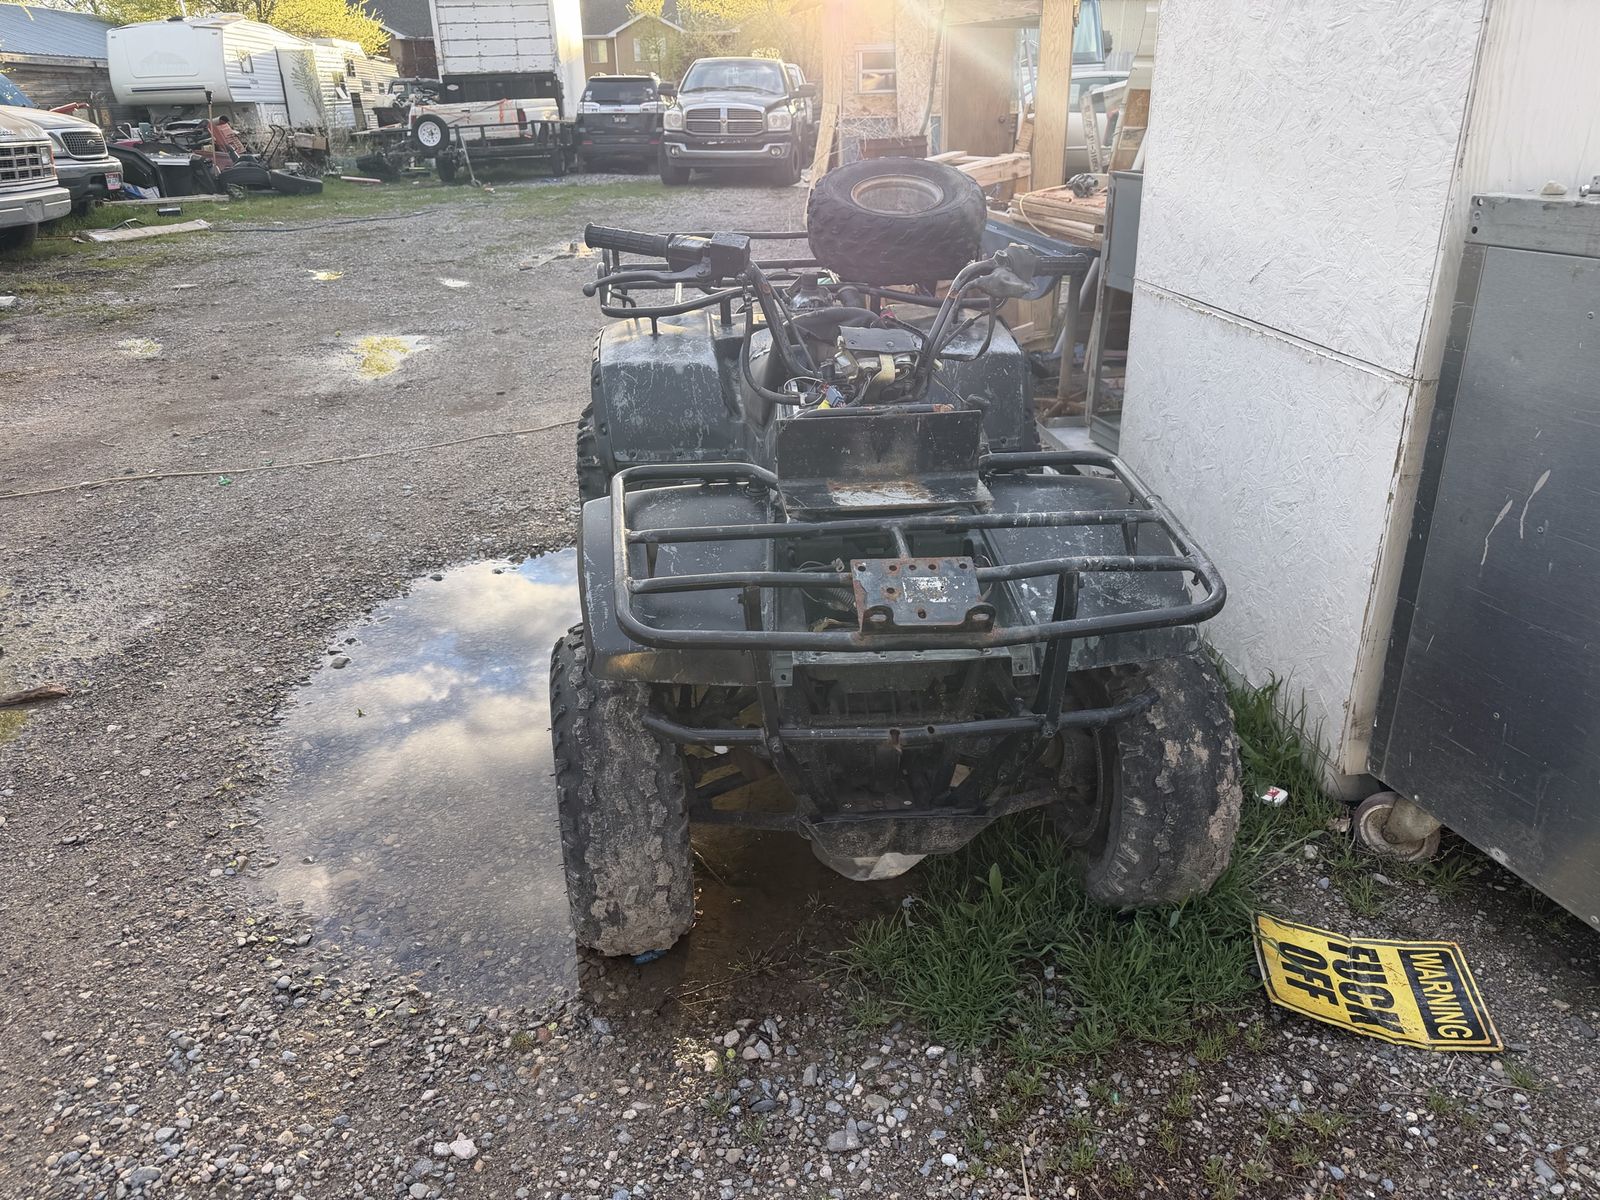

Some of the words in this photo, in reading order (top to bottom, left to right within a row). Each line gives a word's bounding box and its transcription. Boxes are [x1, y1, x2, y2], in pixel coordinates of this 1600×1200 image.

[1278, 941, 1339, 1006] OFF
[1327, 941, 1405, 1034] FUCK
[1409, 952, 1473, 1039] WARNING
